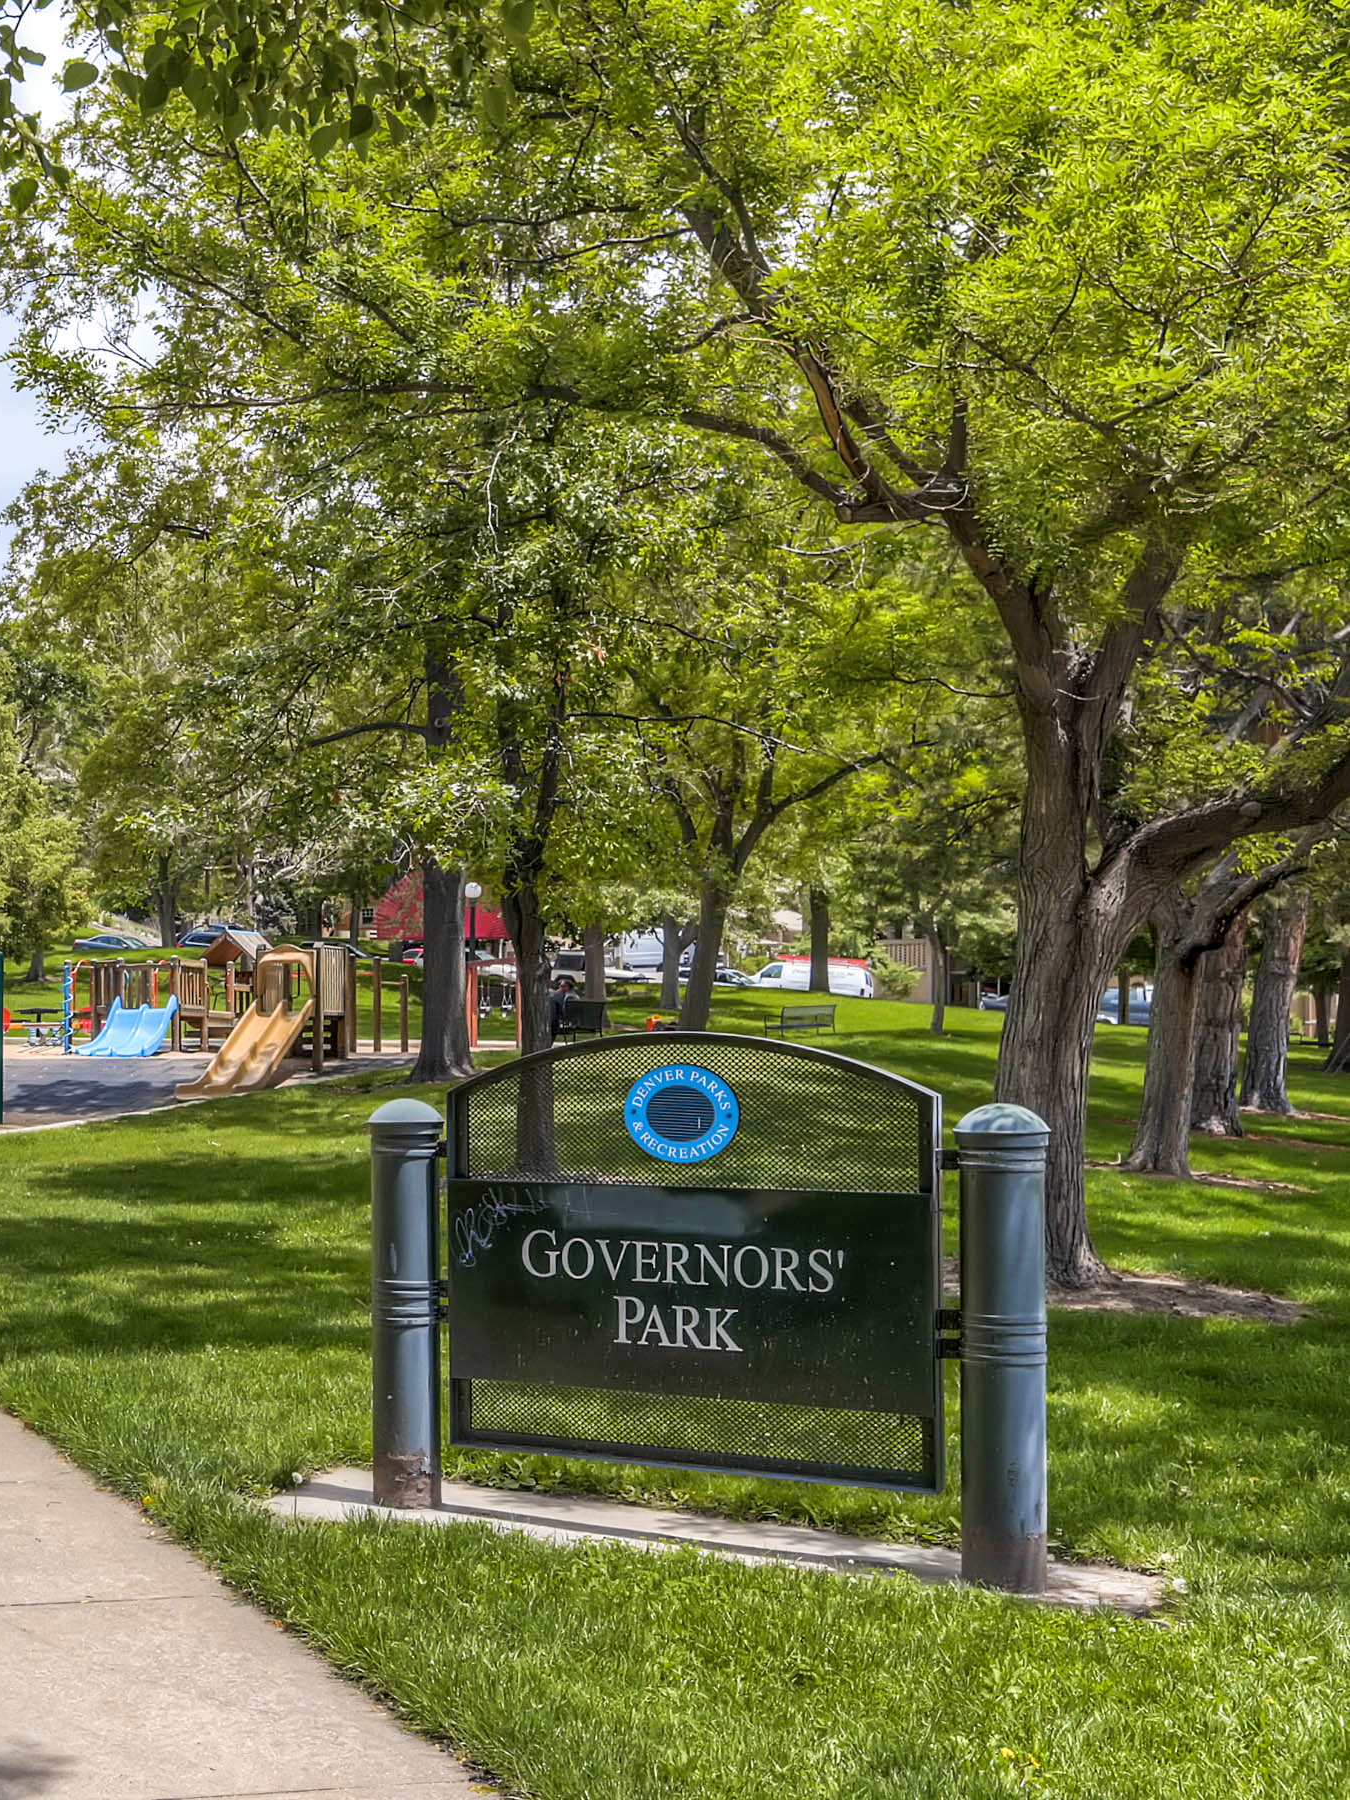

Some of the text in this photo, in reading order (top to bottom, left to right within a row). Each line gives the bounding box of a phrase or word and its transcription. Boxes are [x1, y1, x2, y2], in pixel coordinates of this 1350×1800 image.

[631, 1068, 731, 1111] DENVER PARKS
[632, 1121, 730, 1159] & RECREATION
[521, 1229, 844, 1293] GOVERNORS'
[612, 1295, 744, 1352] PARK
